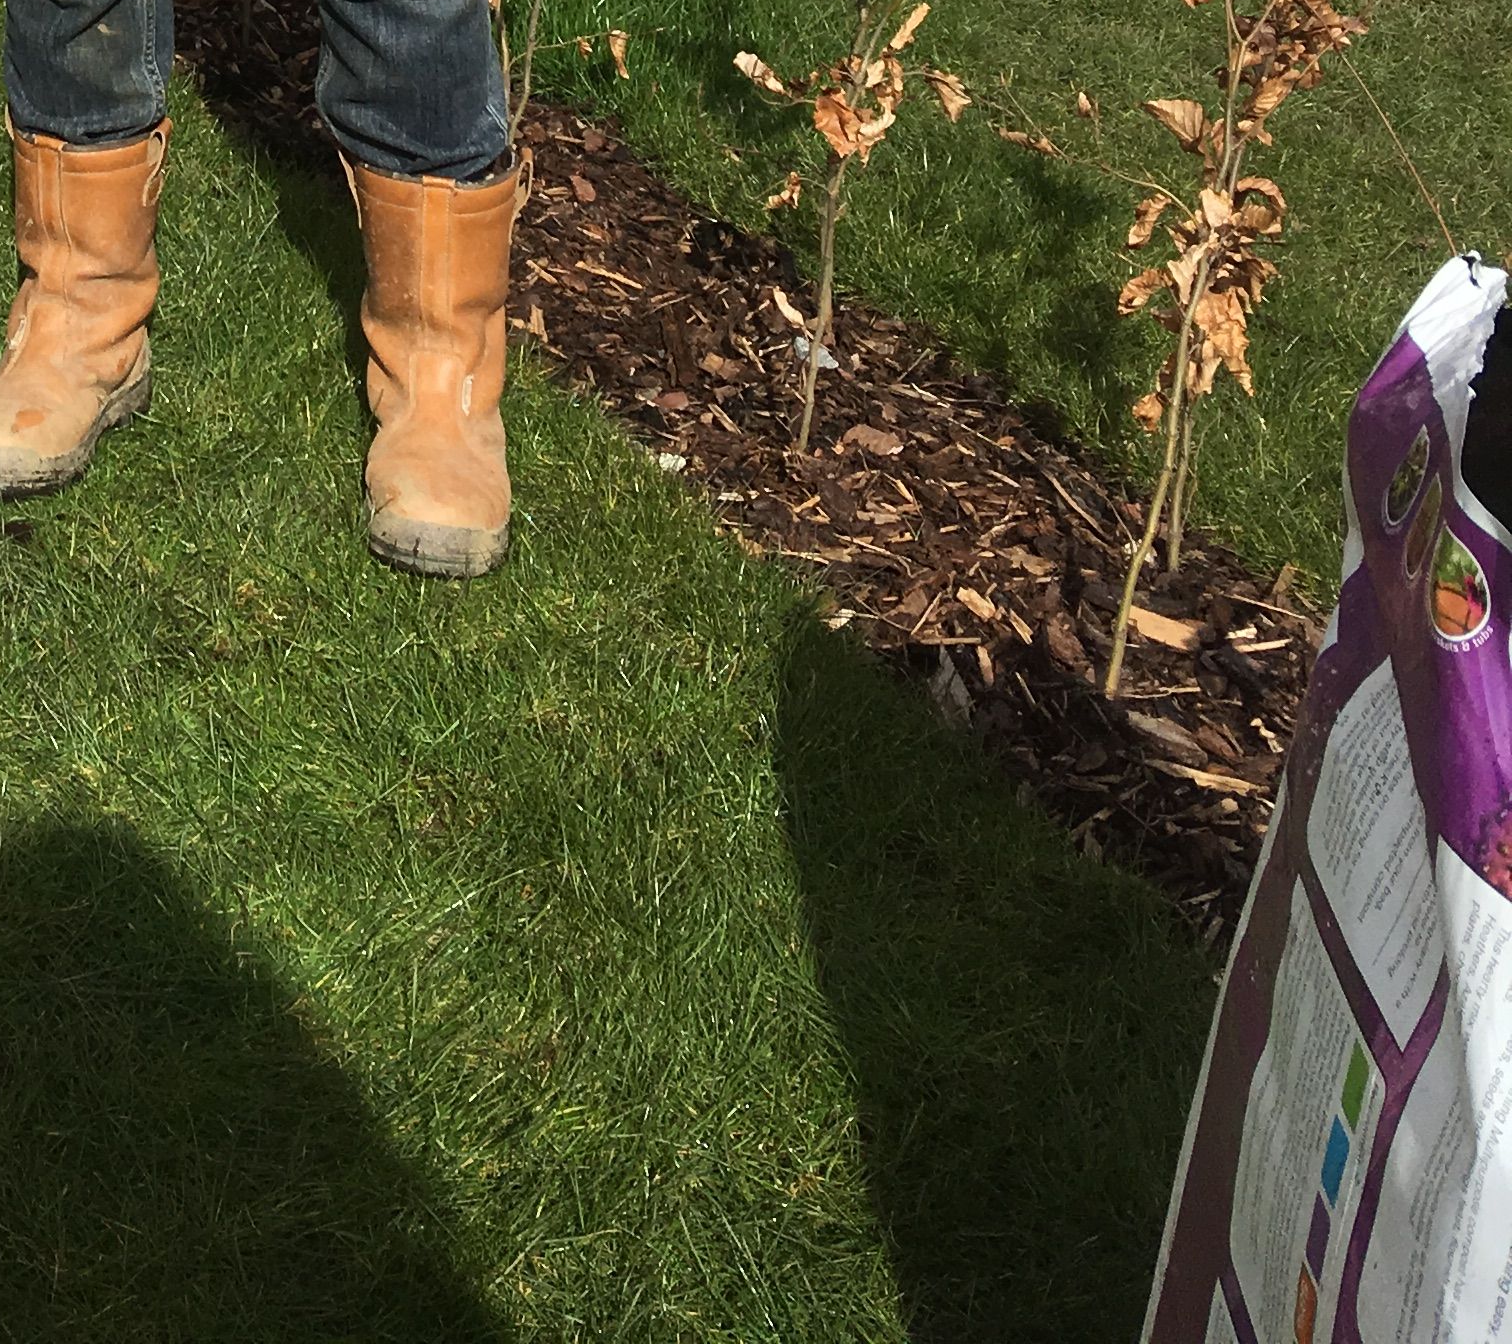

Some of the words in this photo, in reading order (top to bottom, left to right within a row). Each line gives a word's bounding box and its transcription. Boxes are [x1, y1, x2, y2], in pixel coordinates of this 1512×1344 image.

[1461, 640, 1471, 652] &
[1472, 624, 1494, 648] tubs
[1465, 913, 1498, 977] Heathers,
[1491, 926, 1511, 955] This
[1473, 955, 1499, 1000] hearty
[1480, 1067, 1505, 1109] seeds
